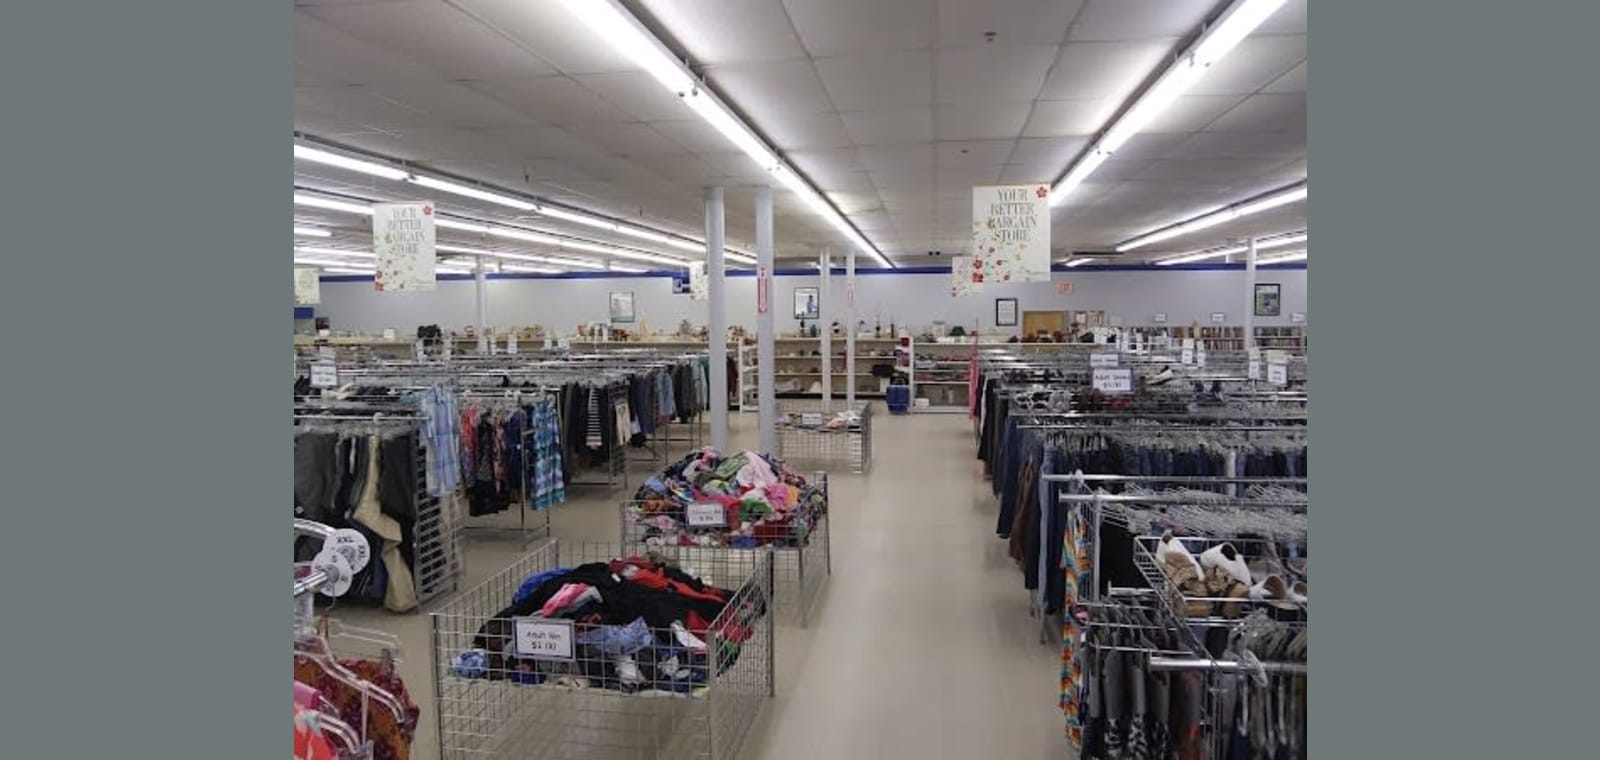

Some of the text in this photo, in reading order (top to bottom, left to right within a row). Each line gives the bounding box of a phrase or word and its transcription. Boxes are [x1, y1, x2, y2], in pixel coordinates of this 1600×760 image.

[998, 188, 1028, 201] YOUR
[990, 203, 1034, 216] BETTER
[994, 230, 1028, 242] STORE
[336, 535, 355, 544] XXL
